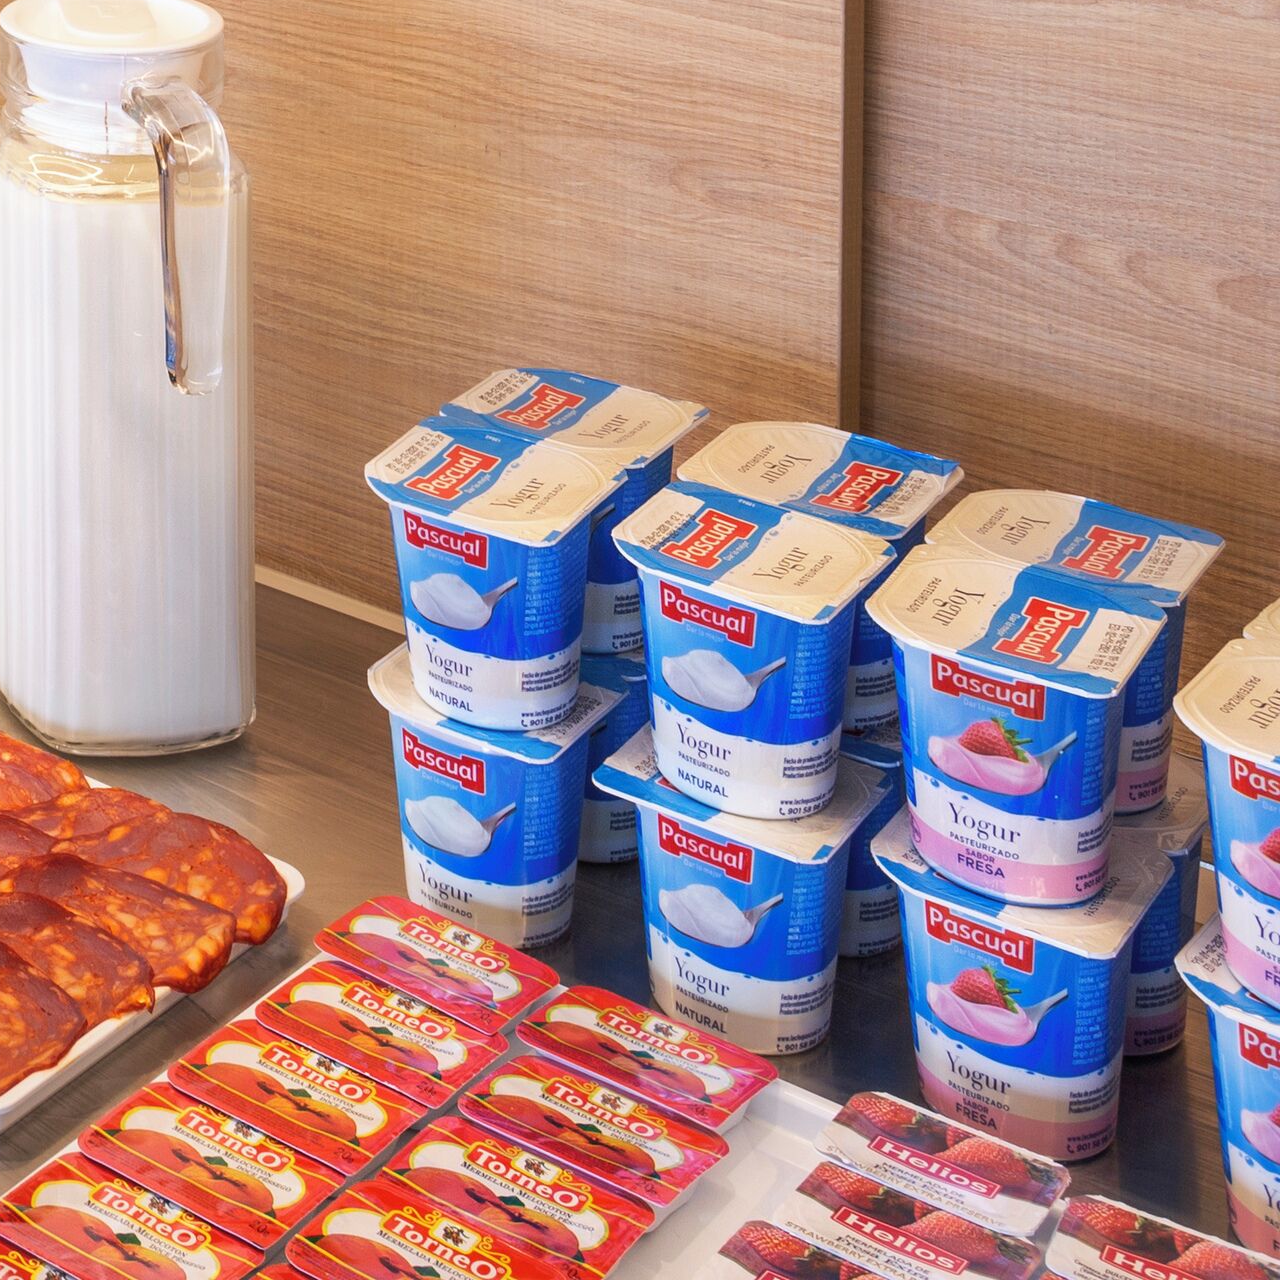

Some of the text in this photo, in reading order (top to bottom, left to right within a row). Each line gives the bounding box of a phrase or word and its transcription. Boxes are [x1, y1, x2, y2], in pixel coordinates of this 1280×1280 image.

[510, 390, 567, 424] Pascual
[579, 413, 630, 439] Yogur
[426, 453, 483, 494] Pascual
[759, 453, 811, 484] Yogur
[491, 478, 544, 510] Yogur
[833, 466, 890, 510] Pascual
[407, 519, 480, 556] Pascual
[677, 517, 731, 561] Pascual
[1000, 516, 1050, 545] Yogur
[753, 547, 808, 580] Yogur
[1085, 532, 1135, 577] Pascual
[664, 588, 747, 634] Pascual
[931, 587, 986, 626] Yogur
[1015, 606, 1075, 658] Pascual
[426, 643, 473, 677] Yogur
[429, 671, 473, 692] PASTEURIZADO
[937, 662, 1035, 709] Pascual
[429, 686, 473, 712] NATURAL
[676, 722, 731, 760] Yogur
[405, 737, 478, 782] Pascual
[678, 751, 730, 776] PASTEURIZADO
[677, 769, 728, 797] NATURAL
[947, 802, 1021, 843] Yogur
[662, 822, 744, 870] Pascual
[950, 832, 1019, 860] PASTEURIZADO
[966, 848, 995, 863] SABOR
[957, 853, 1005, 878] FRESA
[418, 863, 472, 903] Yogur
[421, 890, 472, 918] PASTEURIZADO
[396, 932, 444, 958] MERMELADA
[929, 907, 1024, 960] Pascual
[675, 957, 729, 996] Yogur
[339, 999, 386, 1025] MERMELADA
[676, 985, 729, 1013] PASTEURIZADO
[676, 1001, 727, 1034] NATURAL
[594, 1021, 645, 1048] MERMELADA
[256, 1060, 304, 1088] MERMELADA
[947, 1051, 1011, 1094] Yogur
[539, 1093, 590, 1122] MERMELADA
[949, 1080, 1010, 1111] PASTEURIZADO
[963, 1097, 989, 1115] SABOR
[956, 1103, 997, 1130] FRESA
[172, 1126, 222, 1157] MERMELADA
[461, 1161, 516, 1193] MERMELADA
[882, 1143, 988, 1193] Helios
[84, 1200, 135, 1233] MERMELADA
[377, 1230, 473, 1280] MERMELADA MELOCO
[785, 1221, 867, 1261] STRAWBERRY
[843, 1213, 956, 1270] Helios
